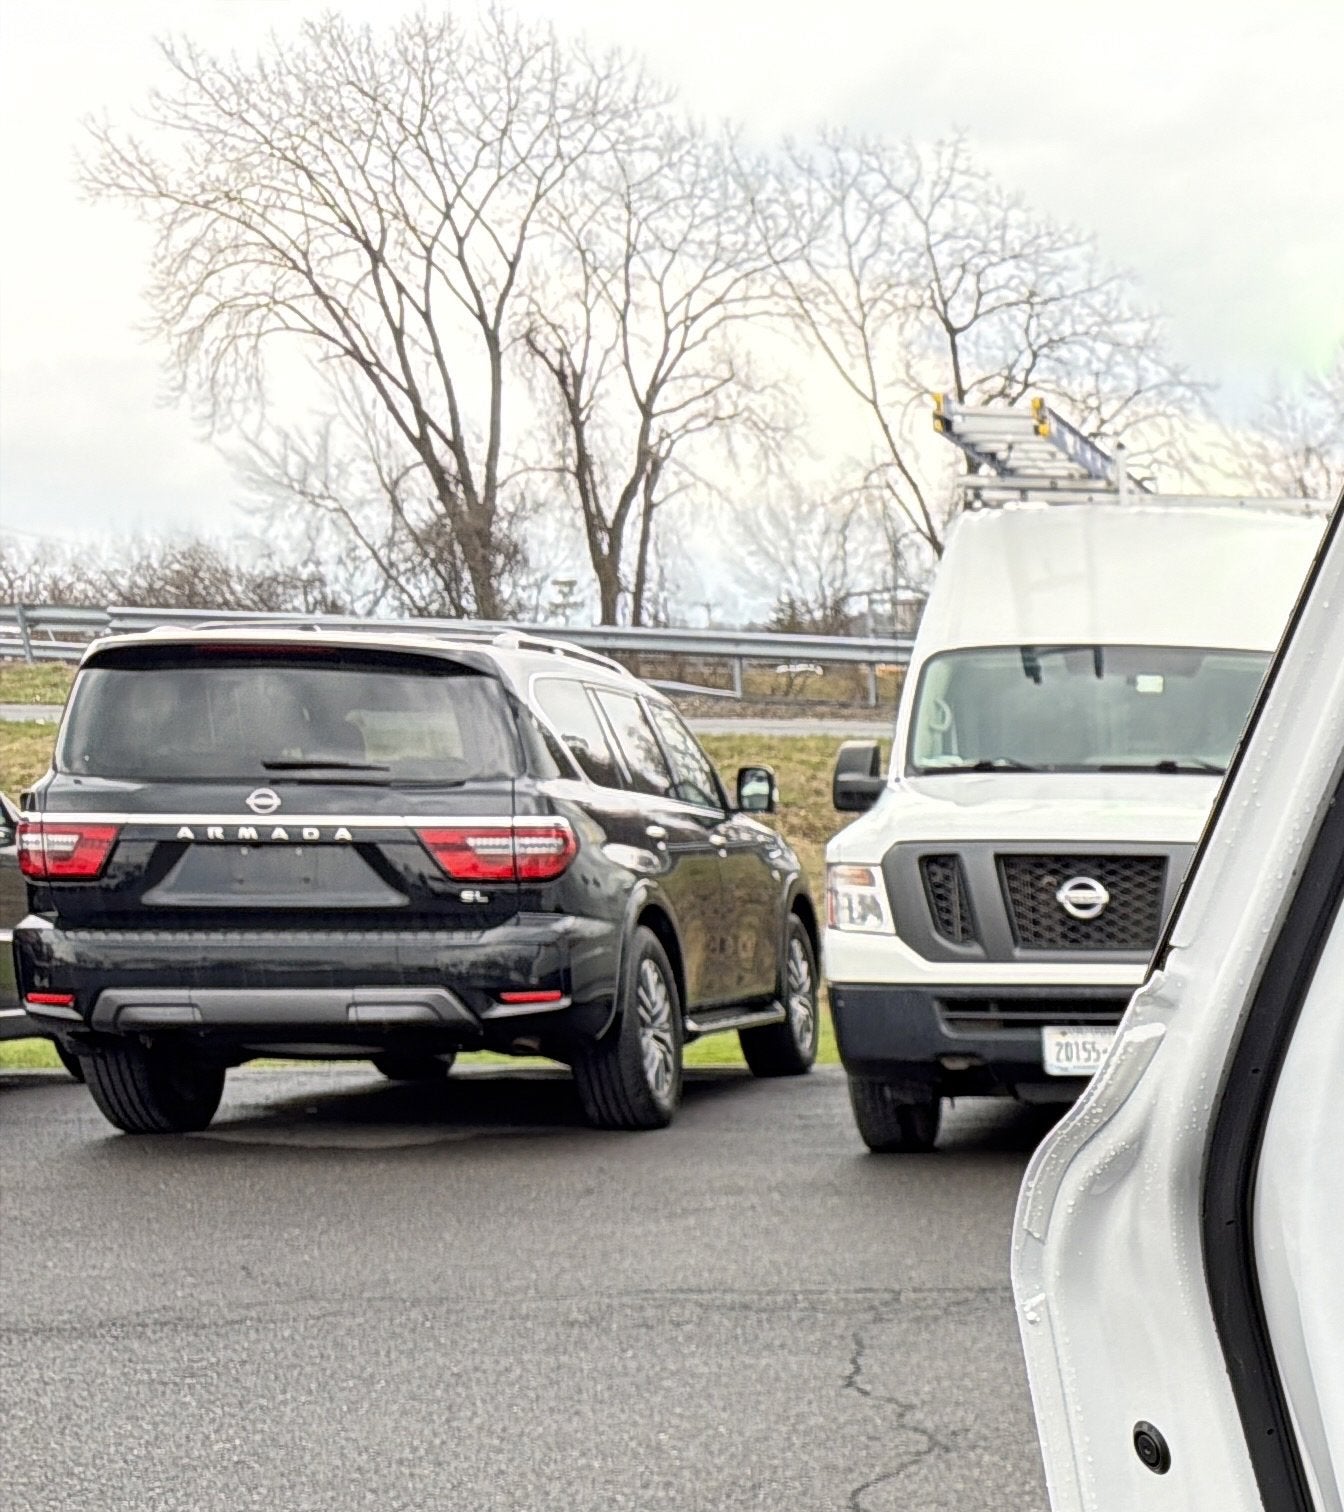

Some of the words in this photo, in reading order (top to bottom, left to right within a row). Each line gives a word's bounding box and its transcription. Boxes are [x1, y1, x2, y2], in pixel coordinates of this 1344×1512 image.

[176, 826, 353, 841] ARMADA
[460, 890, 489, 903] SL
[1055, 1040, 1109, 1063] 20155-
